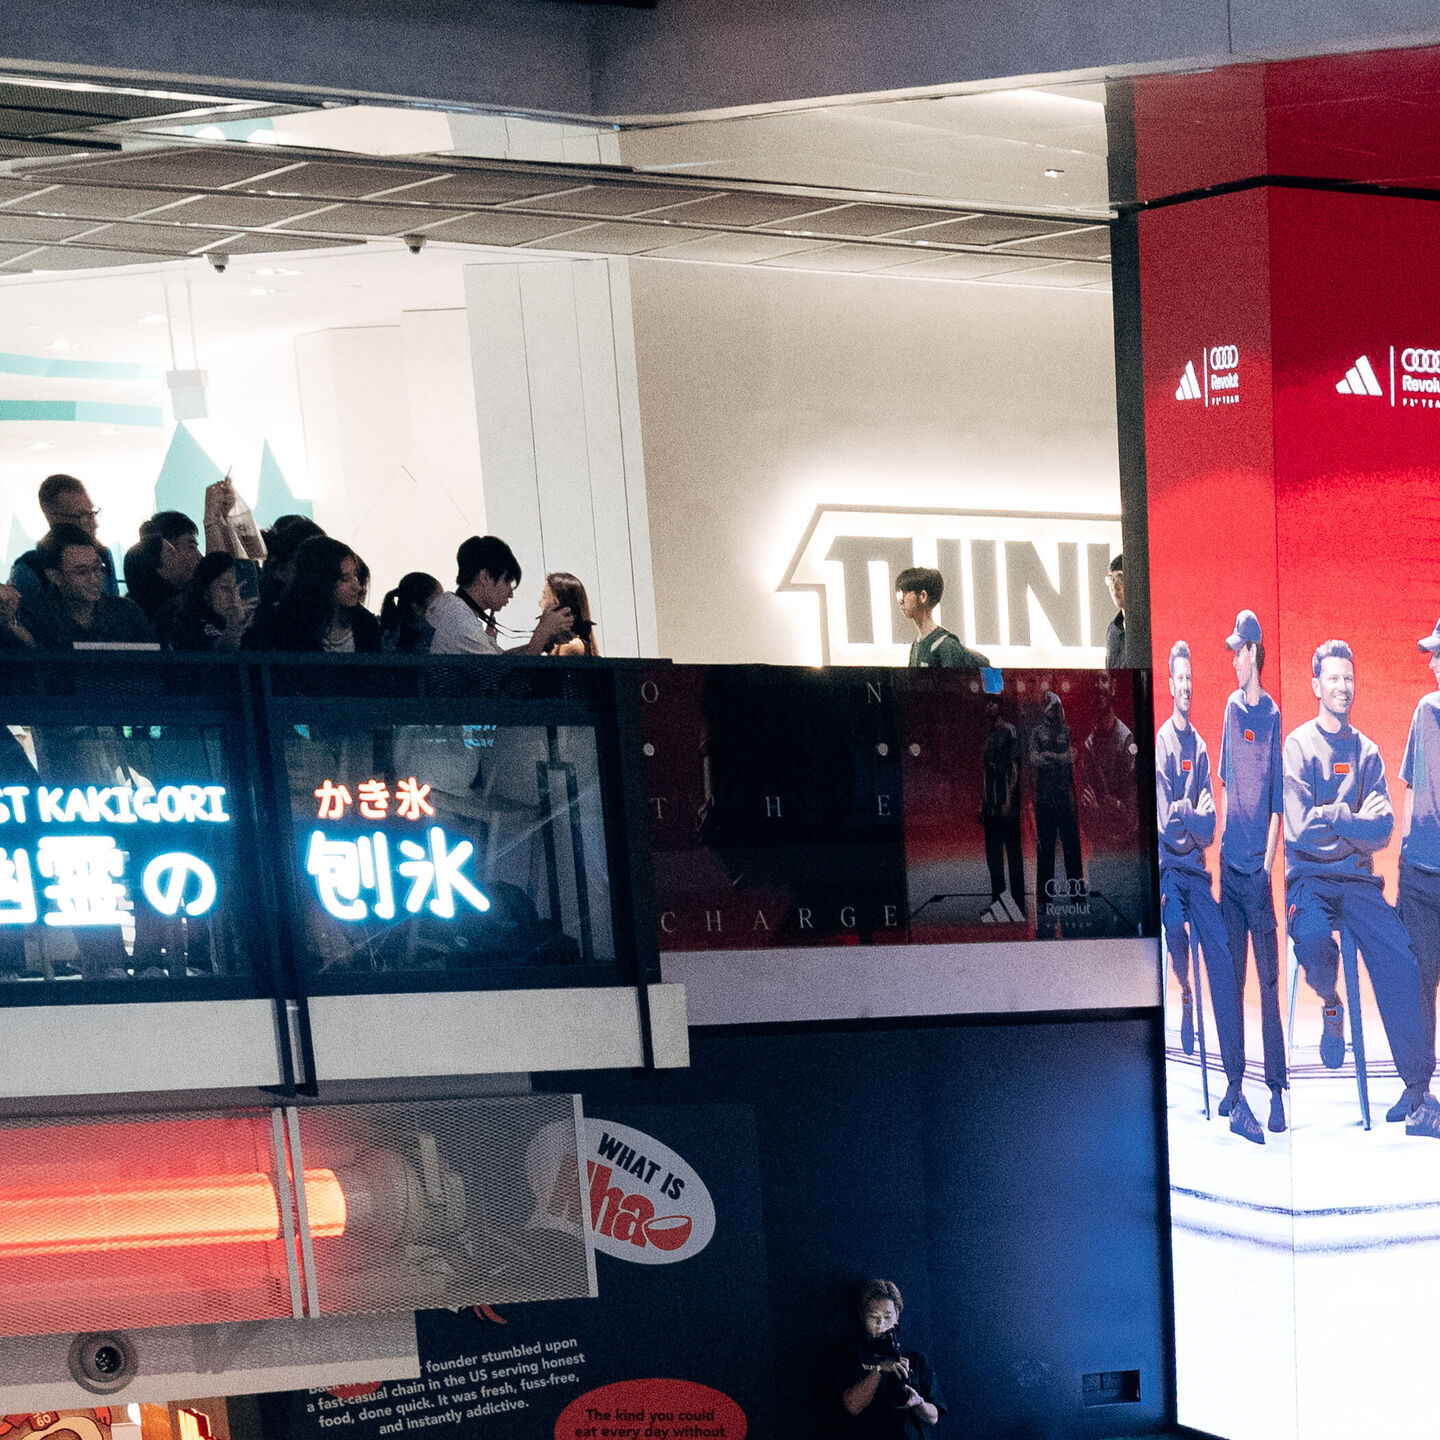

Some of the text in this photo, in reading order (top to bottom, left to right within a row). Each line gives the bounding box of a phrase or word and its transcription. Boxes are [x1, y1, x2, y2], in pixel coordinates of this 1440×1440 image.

[1210, 372, 1239, 390] Revolut
[37, 785, 230, 823] KAKIGORI
[313, 776, 435, 820] かき氷
[1046, 902, 1091, 916] Revolut
[597, 1132, 686, 1201] WHAT IS
[426, 1338, 578, 1373] founder stumbled upon
[306, 1403, 315, 1413] a
[318, 1387, 388, 1411] fast-casual
[391, 1381, 425, 1397] chain
[428, 1377, 441, 1391] in
[443, 1371, 466, 1387] the
[469, 1368, 488, 1384] US
[491, 1361, 539, 1379] serving
[541, 1352, 586, 1369] honest
[318, 1371, 580, 1428] food, done quick. It was fresh, fuss-free,
[379, 1399, 530, 1435] and instantly addictive.
[575, 1425, 726, 1440] eat every day without
[586, 1409, 715, 1424] The kind you could
